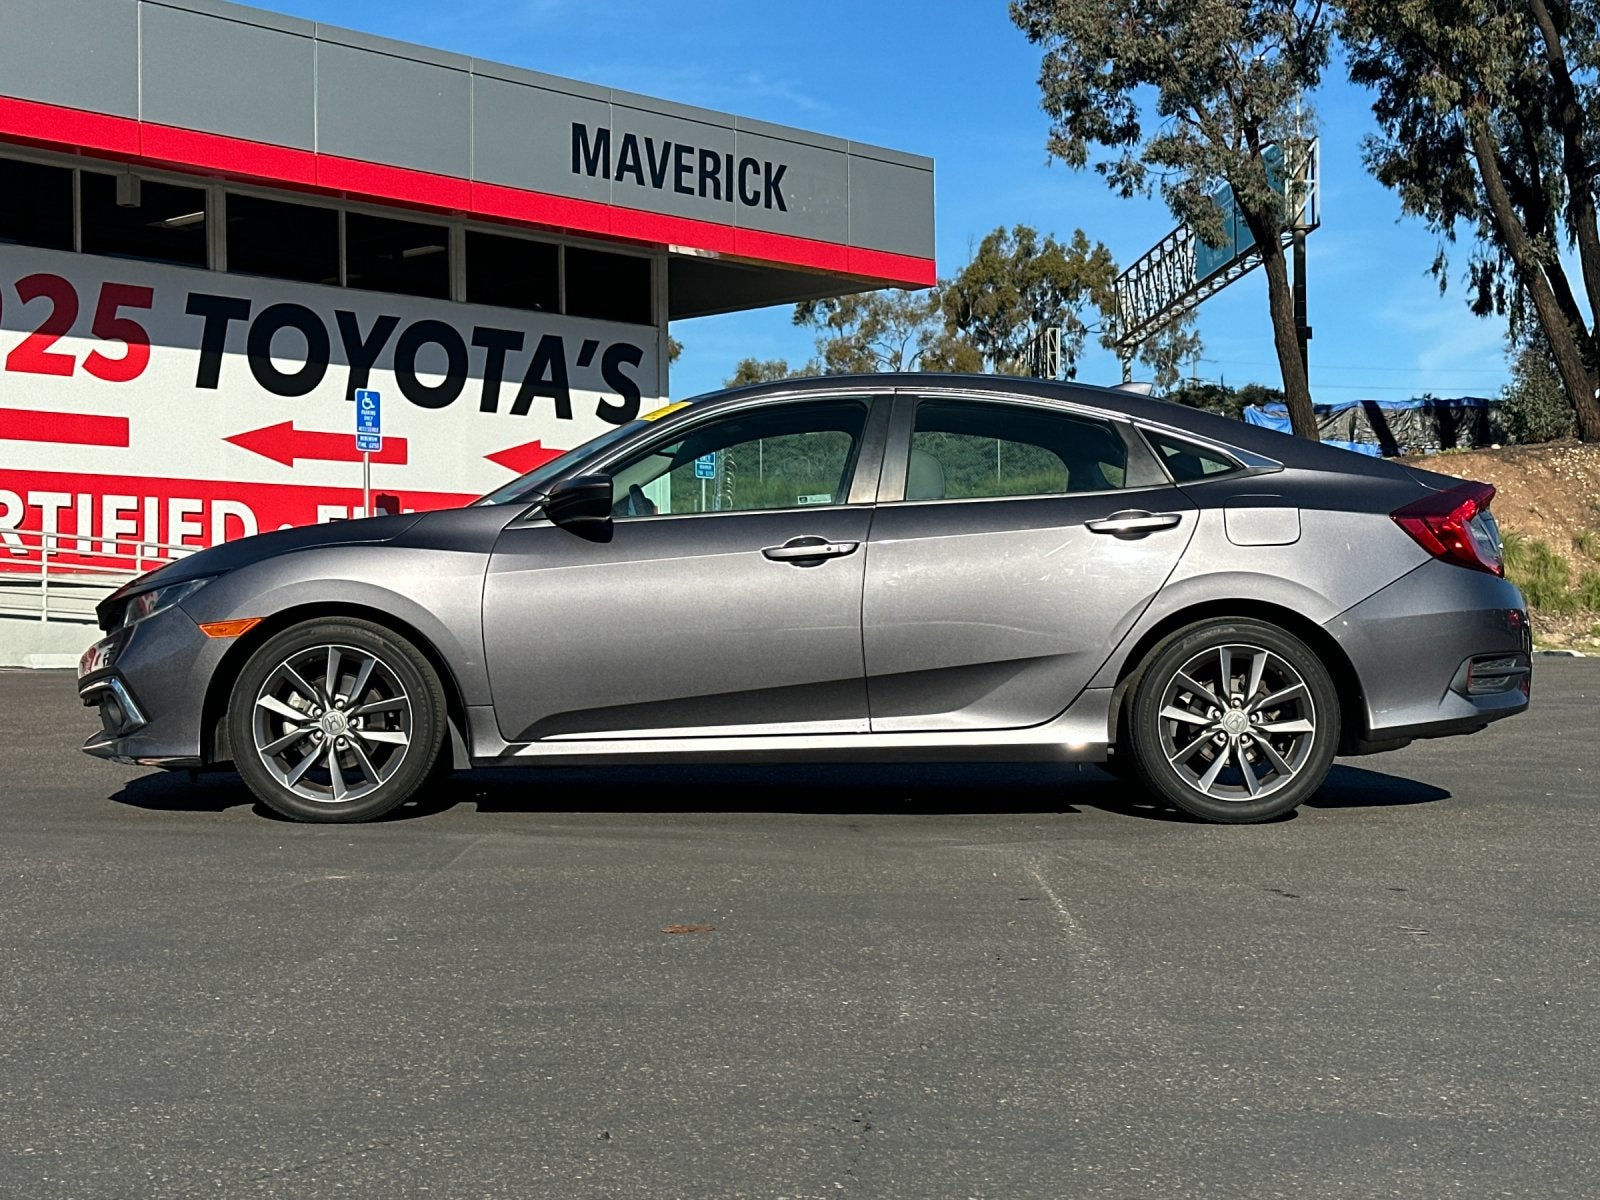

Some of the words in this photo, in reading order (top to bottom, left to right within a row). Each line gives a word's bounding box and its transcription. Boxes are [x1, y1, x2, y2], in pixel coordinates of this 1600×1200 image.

[571, 121, 788, 213] MAVERICK
[0, 273, 154, 382] 25
[185, 292, 644, 425] TOYOTA'S
